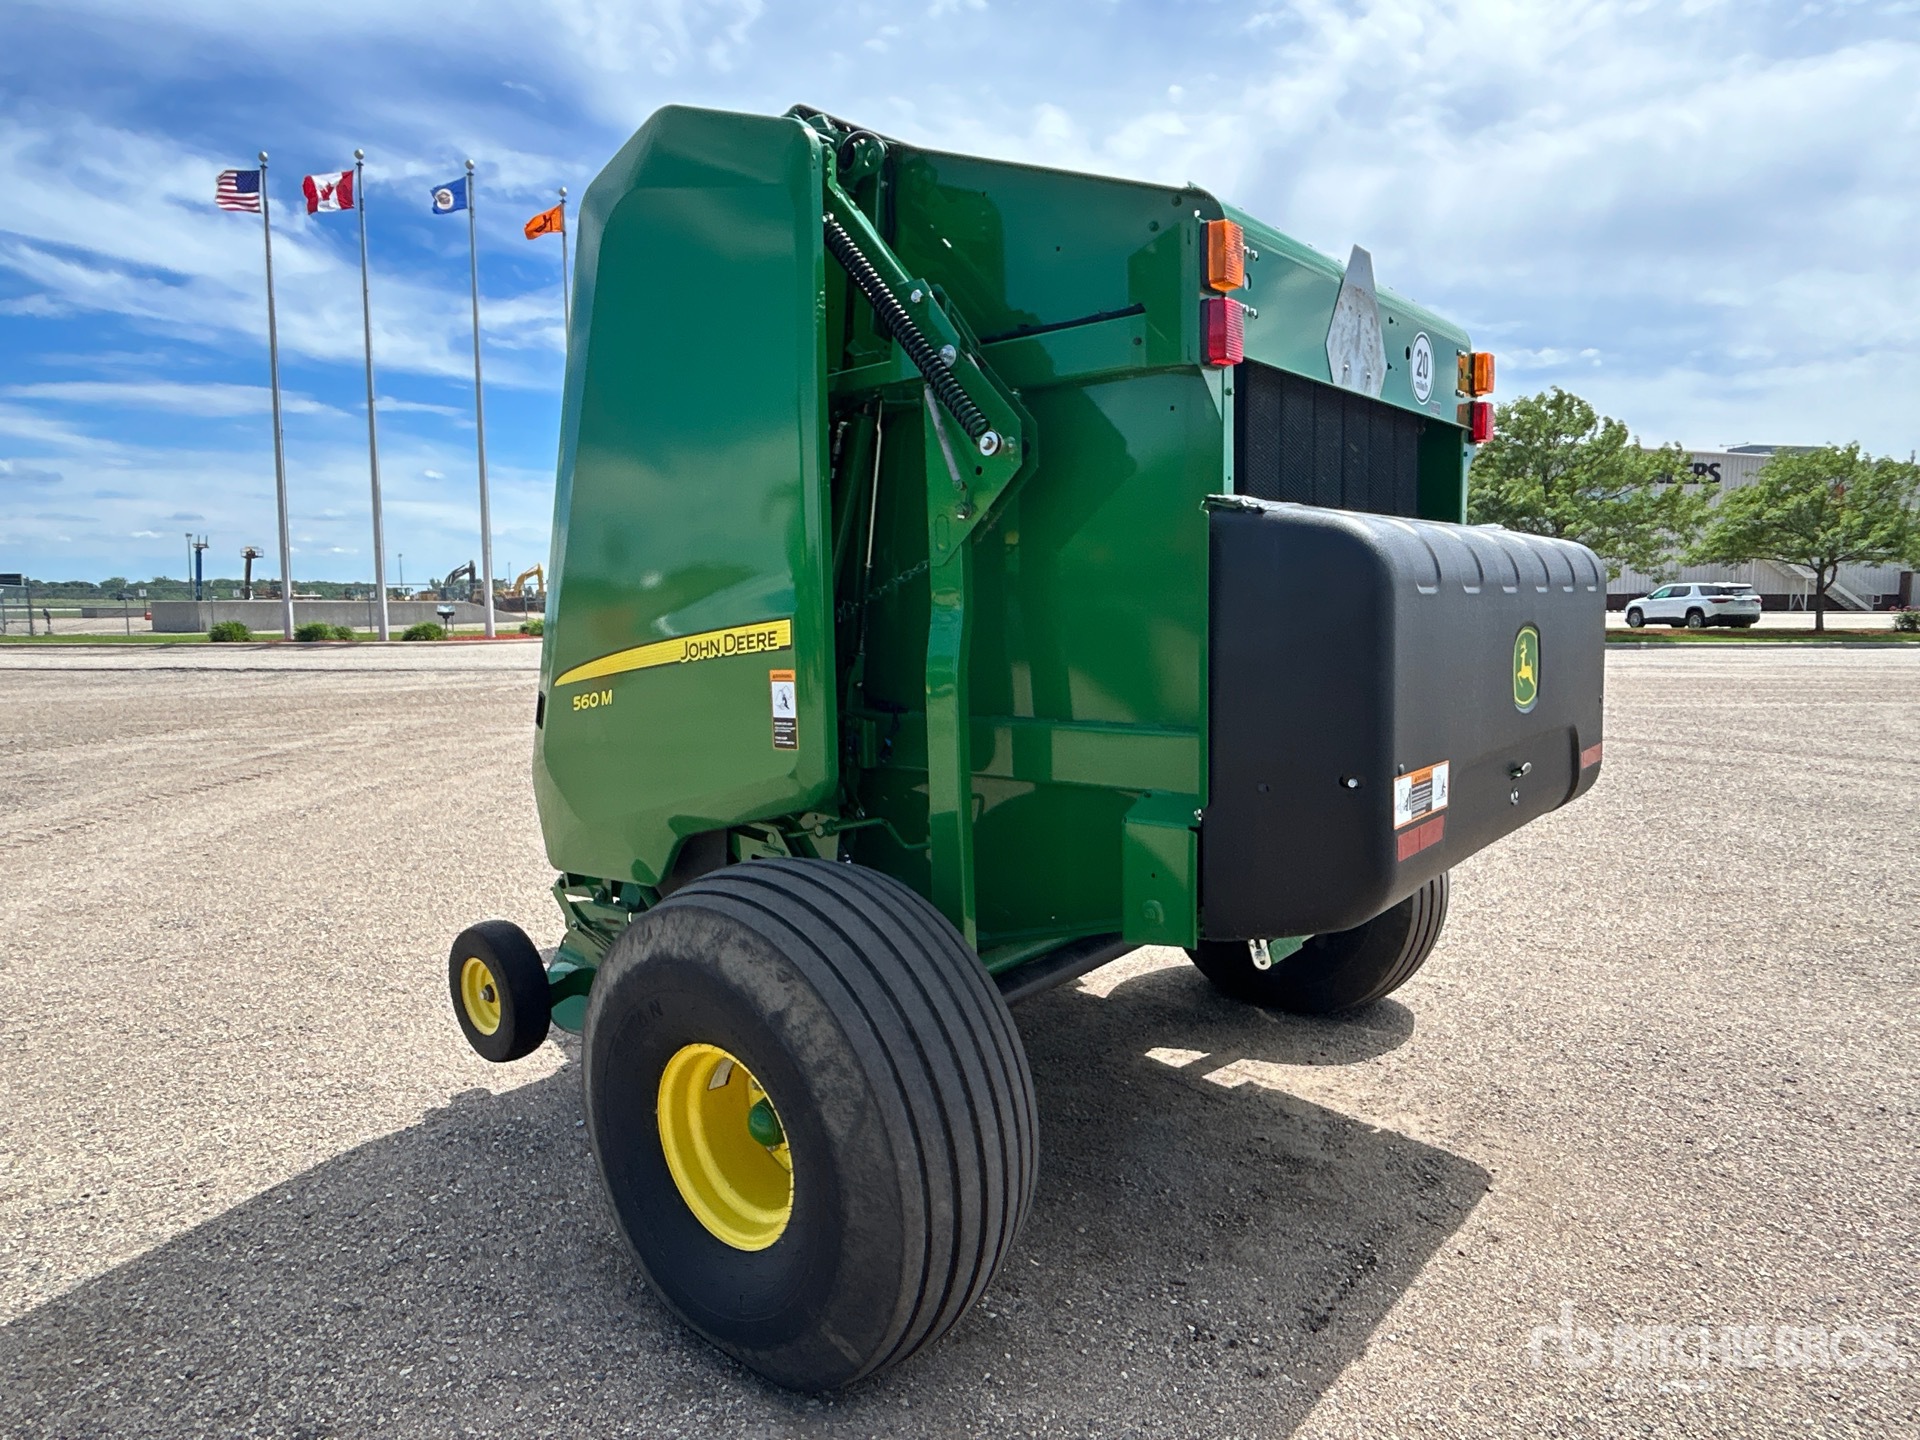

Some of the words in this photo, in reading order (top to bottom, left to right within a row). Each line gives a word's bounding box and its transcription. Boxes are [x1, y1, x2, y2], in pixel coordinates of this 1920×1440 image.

[1416, 348, 1429, 380] 20
[680, 638, 721, 661] JOHN
[723, 630, 778, 653] DEERE
[572, 691, 599, 711] 560
